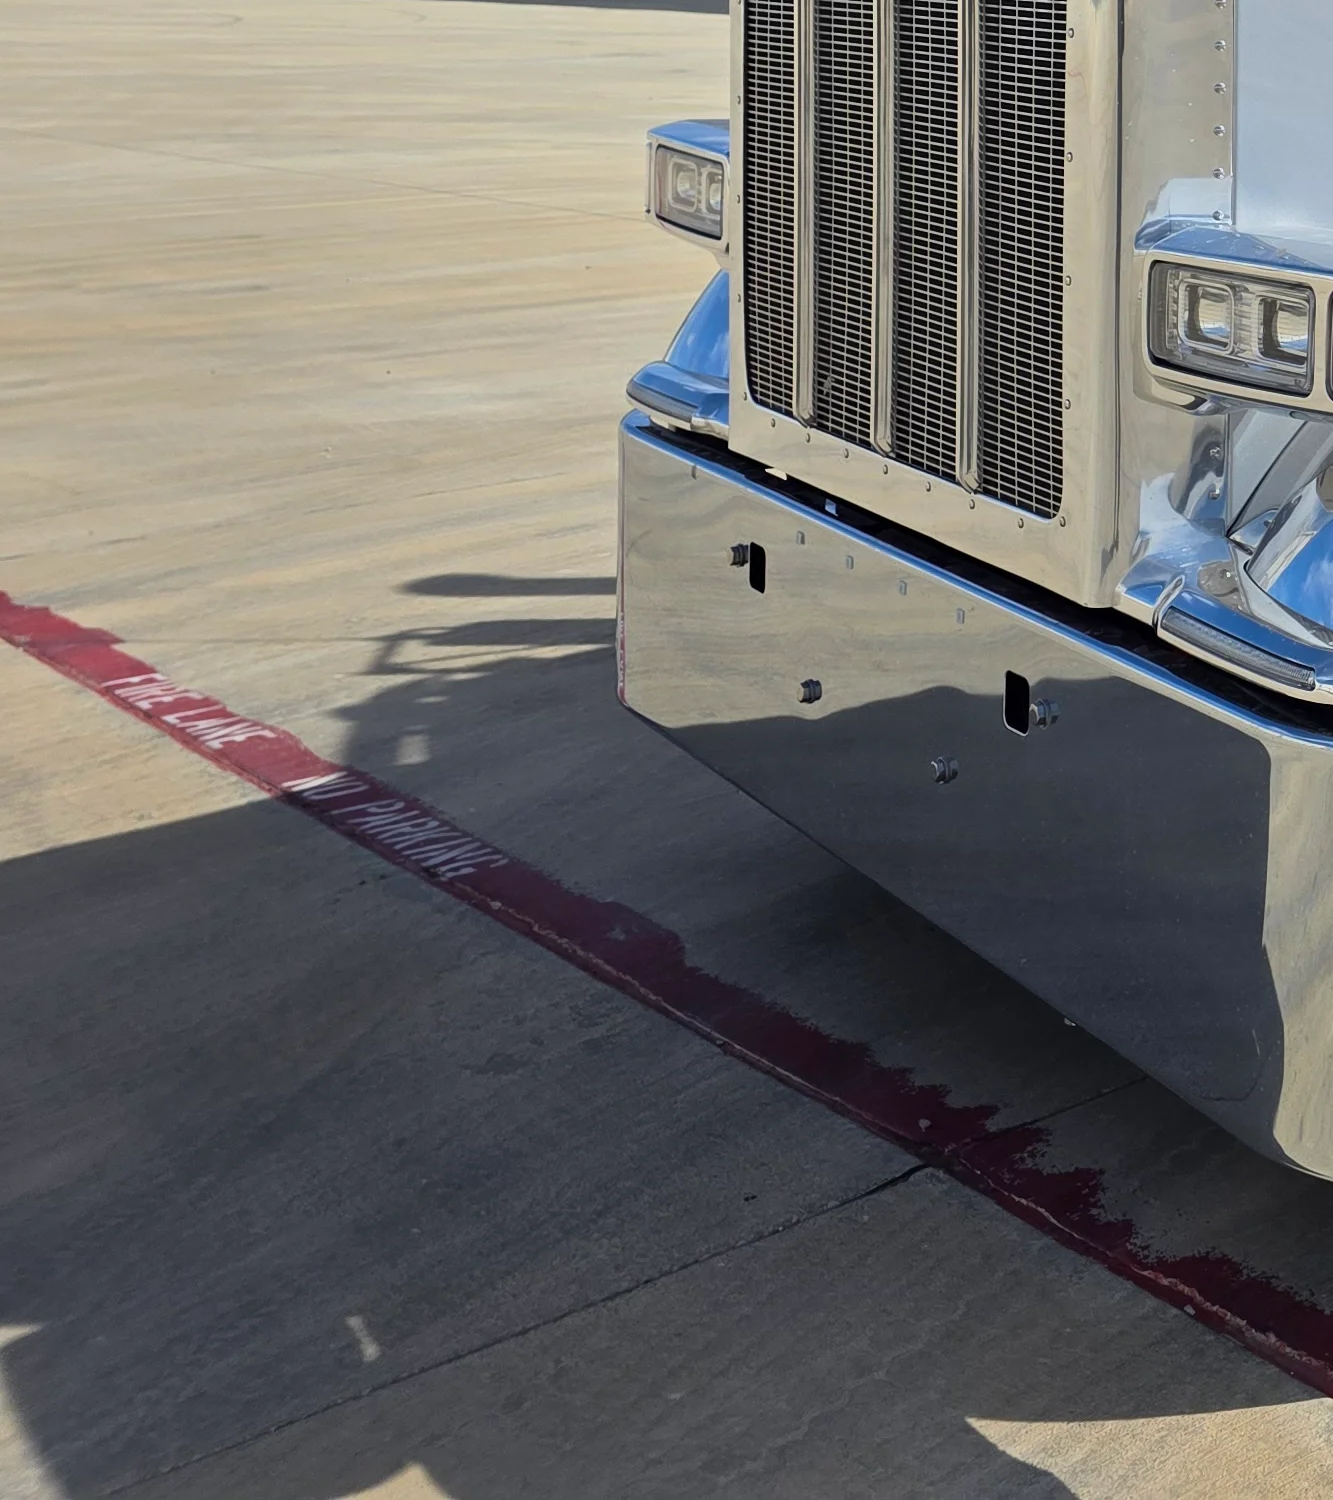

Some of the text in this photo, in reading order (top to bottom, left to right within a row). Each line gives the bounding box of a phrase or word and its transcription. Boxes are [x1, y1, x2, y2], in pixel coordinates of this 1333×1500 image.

[100, 673, 278, 750] FIRE LANE
[280, 771, 509, 881] NO PARKING
